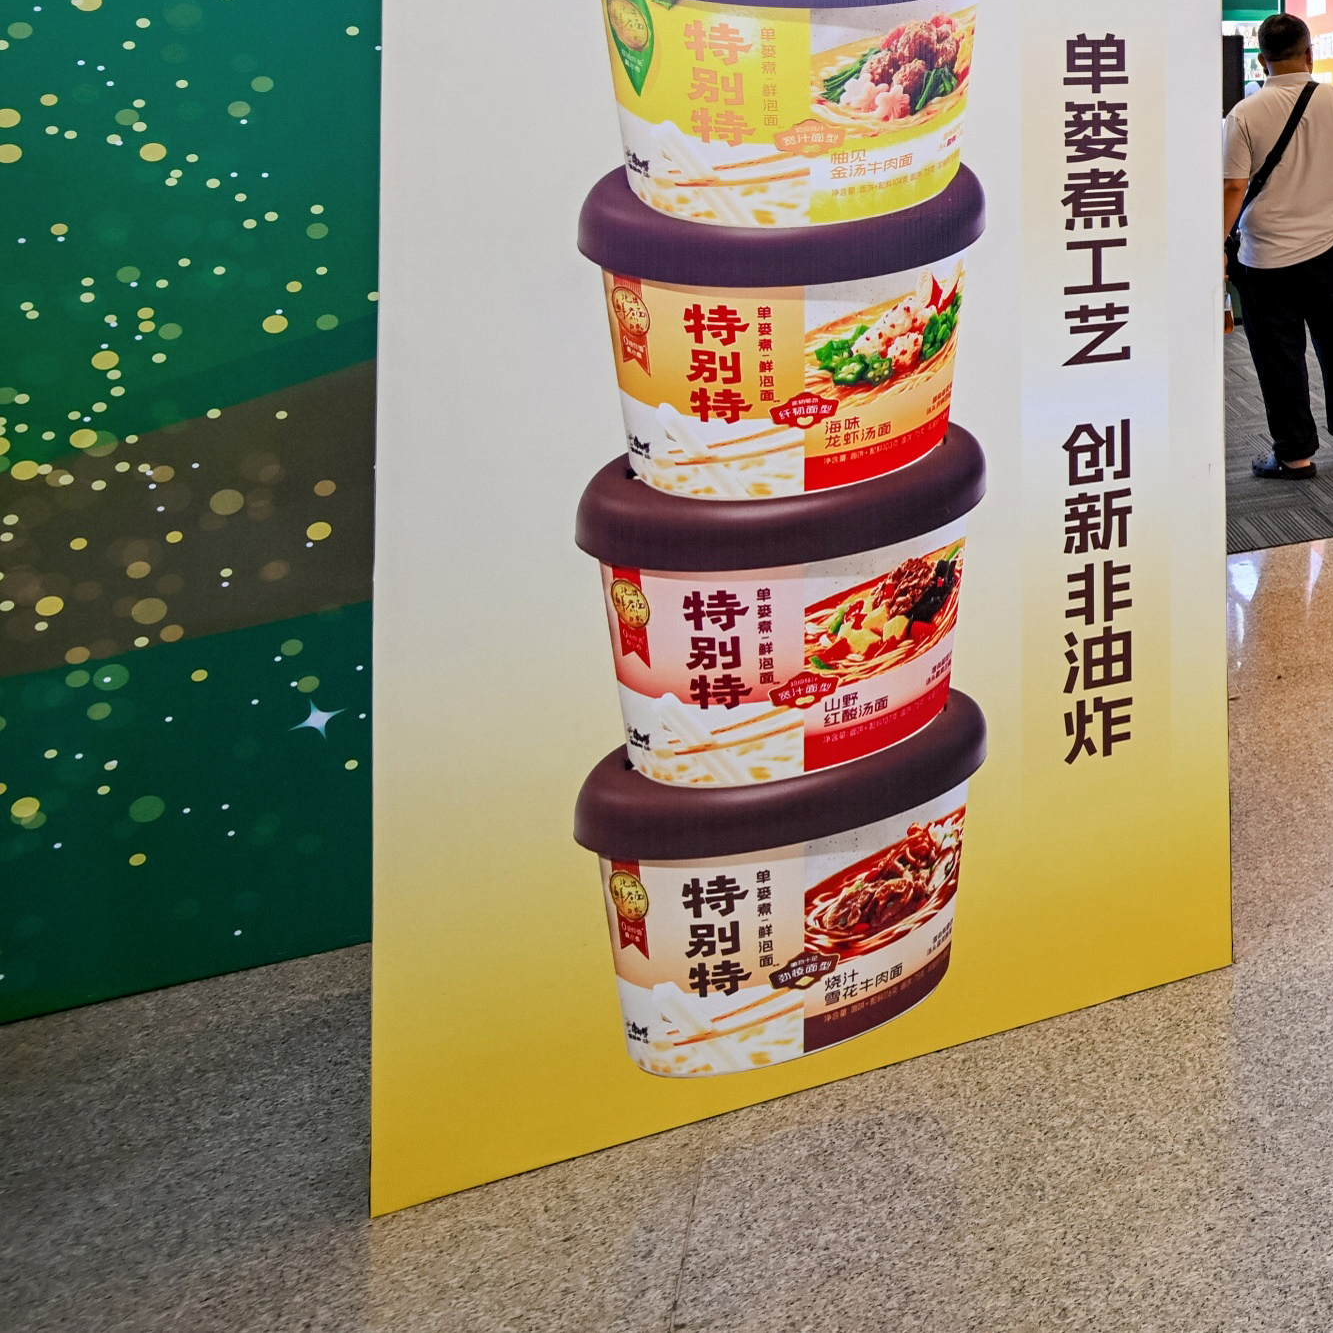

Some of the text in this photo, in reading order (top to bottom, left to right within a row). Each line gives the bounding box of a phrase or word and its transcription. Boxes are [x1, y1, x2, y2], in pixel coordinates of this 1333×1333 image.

[683, 19, 756, 147] 特别特
[830, 152, 913, 180] 金汤牛肉面
[682, 303, 753, 425] 特别特
[1060, 33, 1133, 766] 单篓煮工艺 创新非油炸
[825, 416, 860, 435] 海味
[825, 421, 892, 449] 龙虾汤面
[682, 589, 752, 711] 特别特
[824, 695, 889, 727] 红酸汤面
[825, 691, 858, 713] 山野
[681, 874, 752, 999] 特别特
[825, 968, 859, 992] 烧汁
[825, 962, 903, 1007] 雪花牛肉面
